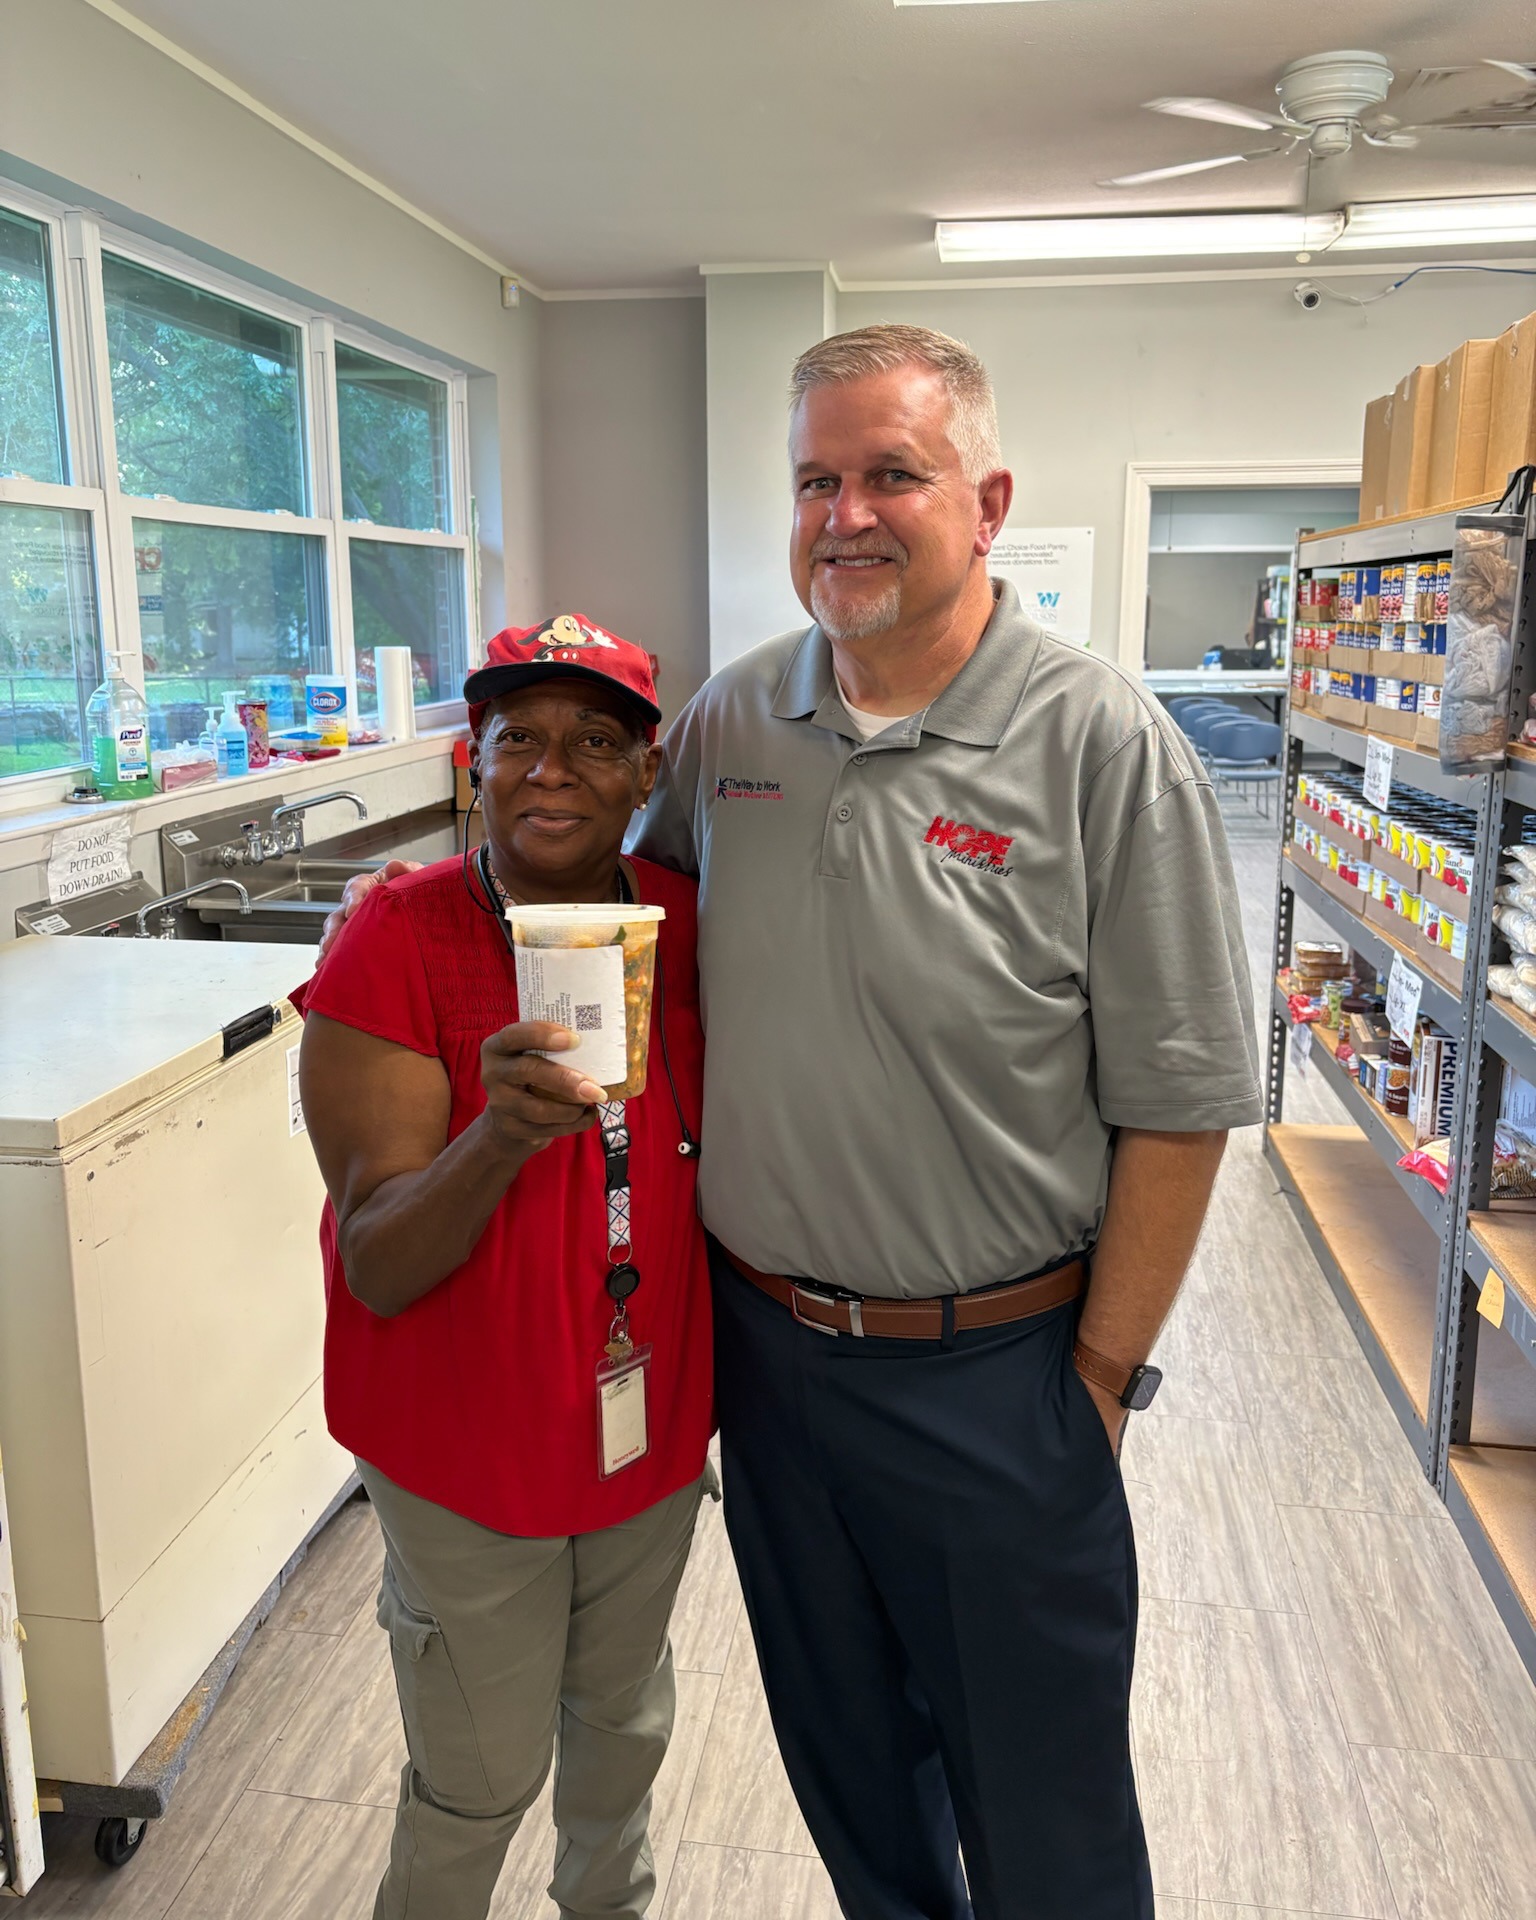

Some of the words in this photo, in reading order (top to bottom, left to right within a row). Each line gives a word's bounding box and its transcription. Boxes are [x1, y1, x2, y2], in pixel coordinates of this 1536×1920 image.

[1007, 543, 1029, 551] Choice
[1030, 543, 1047, 551] Food
[1048, 543, 1068, 551] Pantry
[313, 697, 338, 707] CLOROX
[728, 778, 741, 790] The
[741, 779, 756, 793] Way
[756, 780, 763, 791] to
[763, 780, 781, 792] Work
[77, 838, 93, 852] DO
[93, 832, 111, 849] NOT
[923, 815, 1015, 867] HOPE
[70, 858, 90, 873] PUT
[91, 851, 114, 868] FOOD
[59, 877, 90, 896] DOWN
[91, 867, 123, 887] DRAIN!
[1437, 1041, 1458, 1136] PREMIUM
